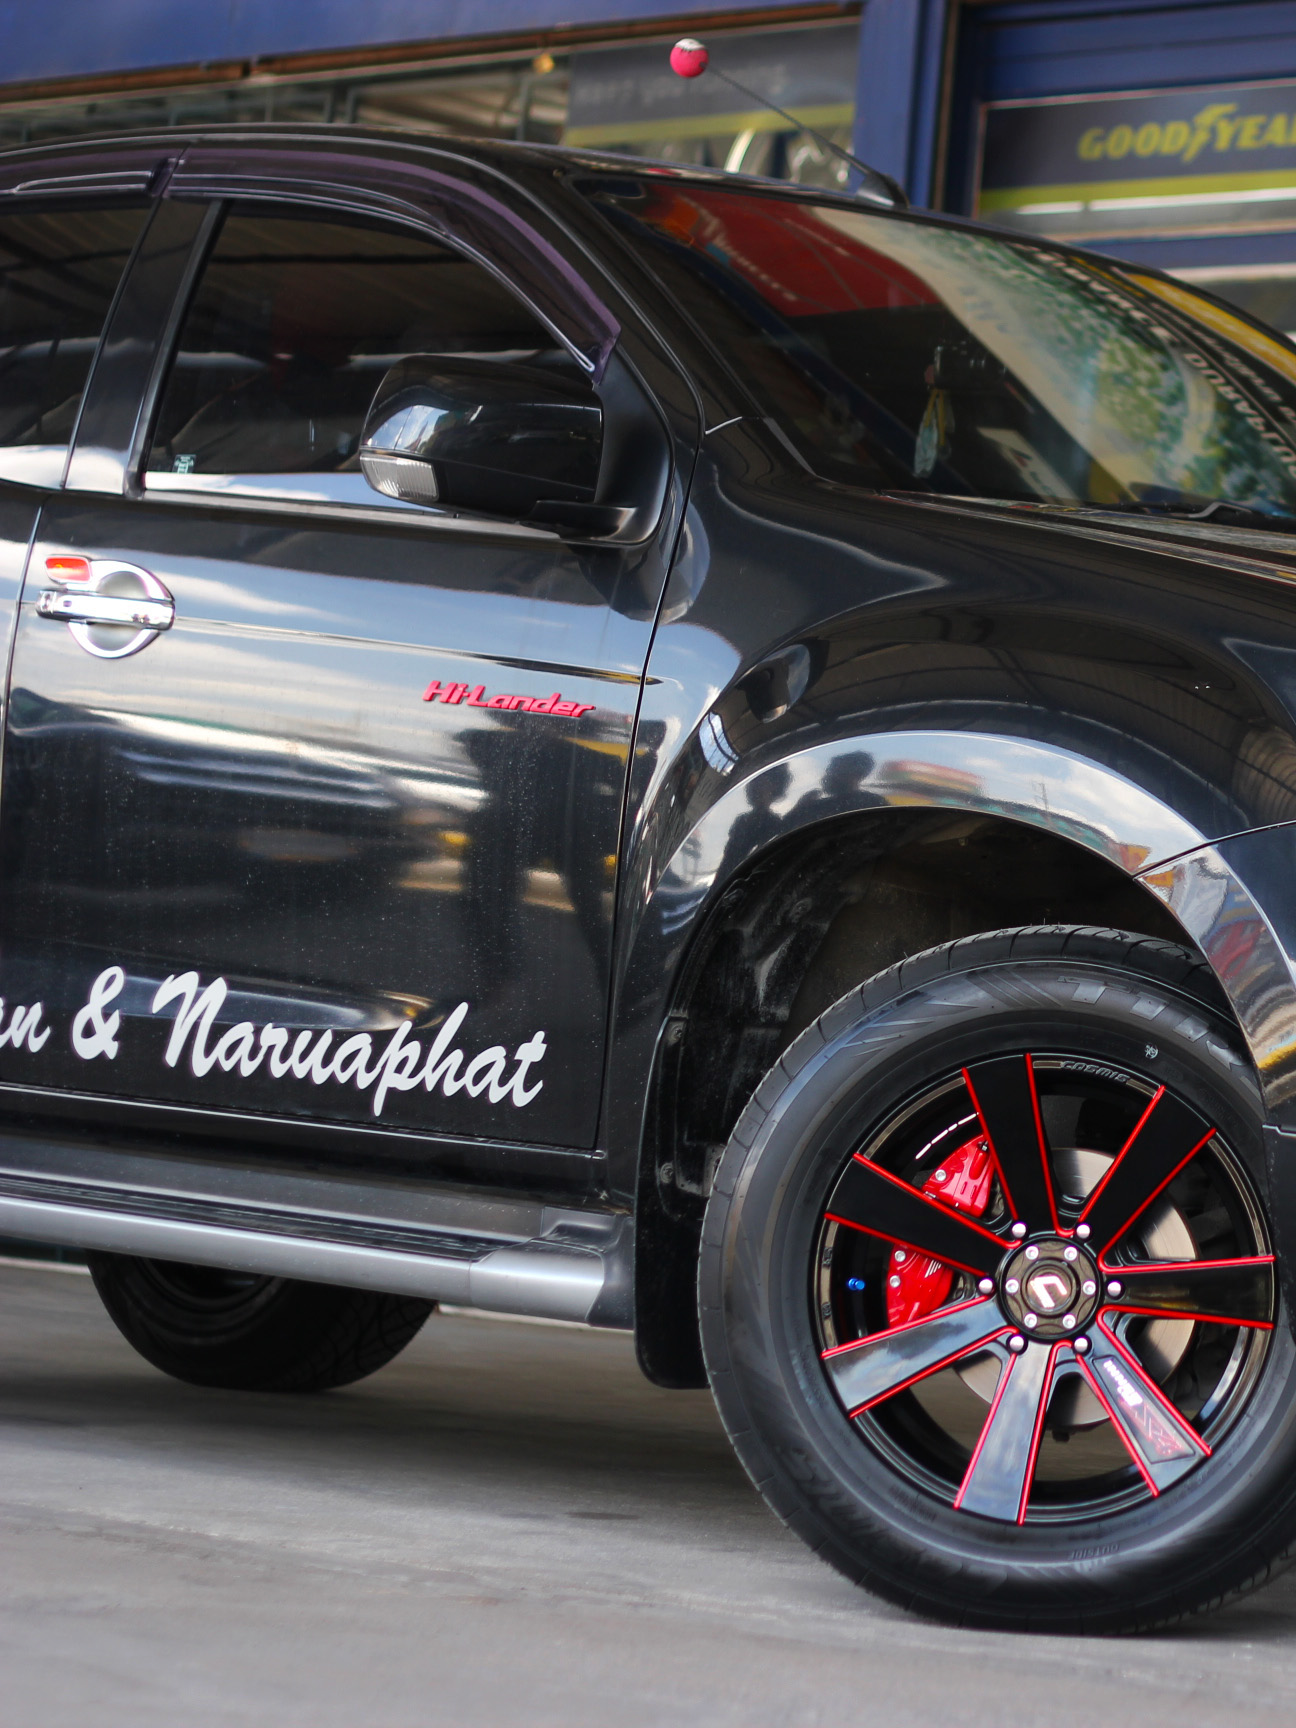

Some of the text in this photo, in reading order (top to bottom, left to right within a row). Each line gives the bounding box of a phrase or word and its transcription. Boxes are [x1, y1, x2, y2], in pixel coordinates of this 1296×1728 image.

[422, 680, 596, 718] Hi-Lander
[0, 966, 547, 1116] n & Naruaphat
[1060, 1060, 1131, 1083] COSMIS
